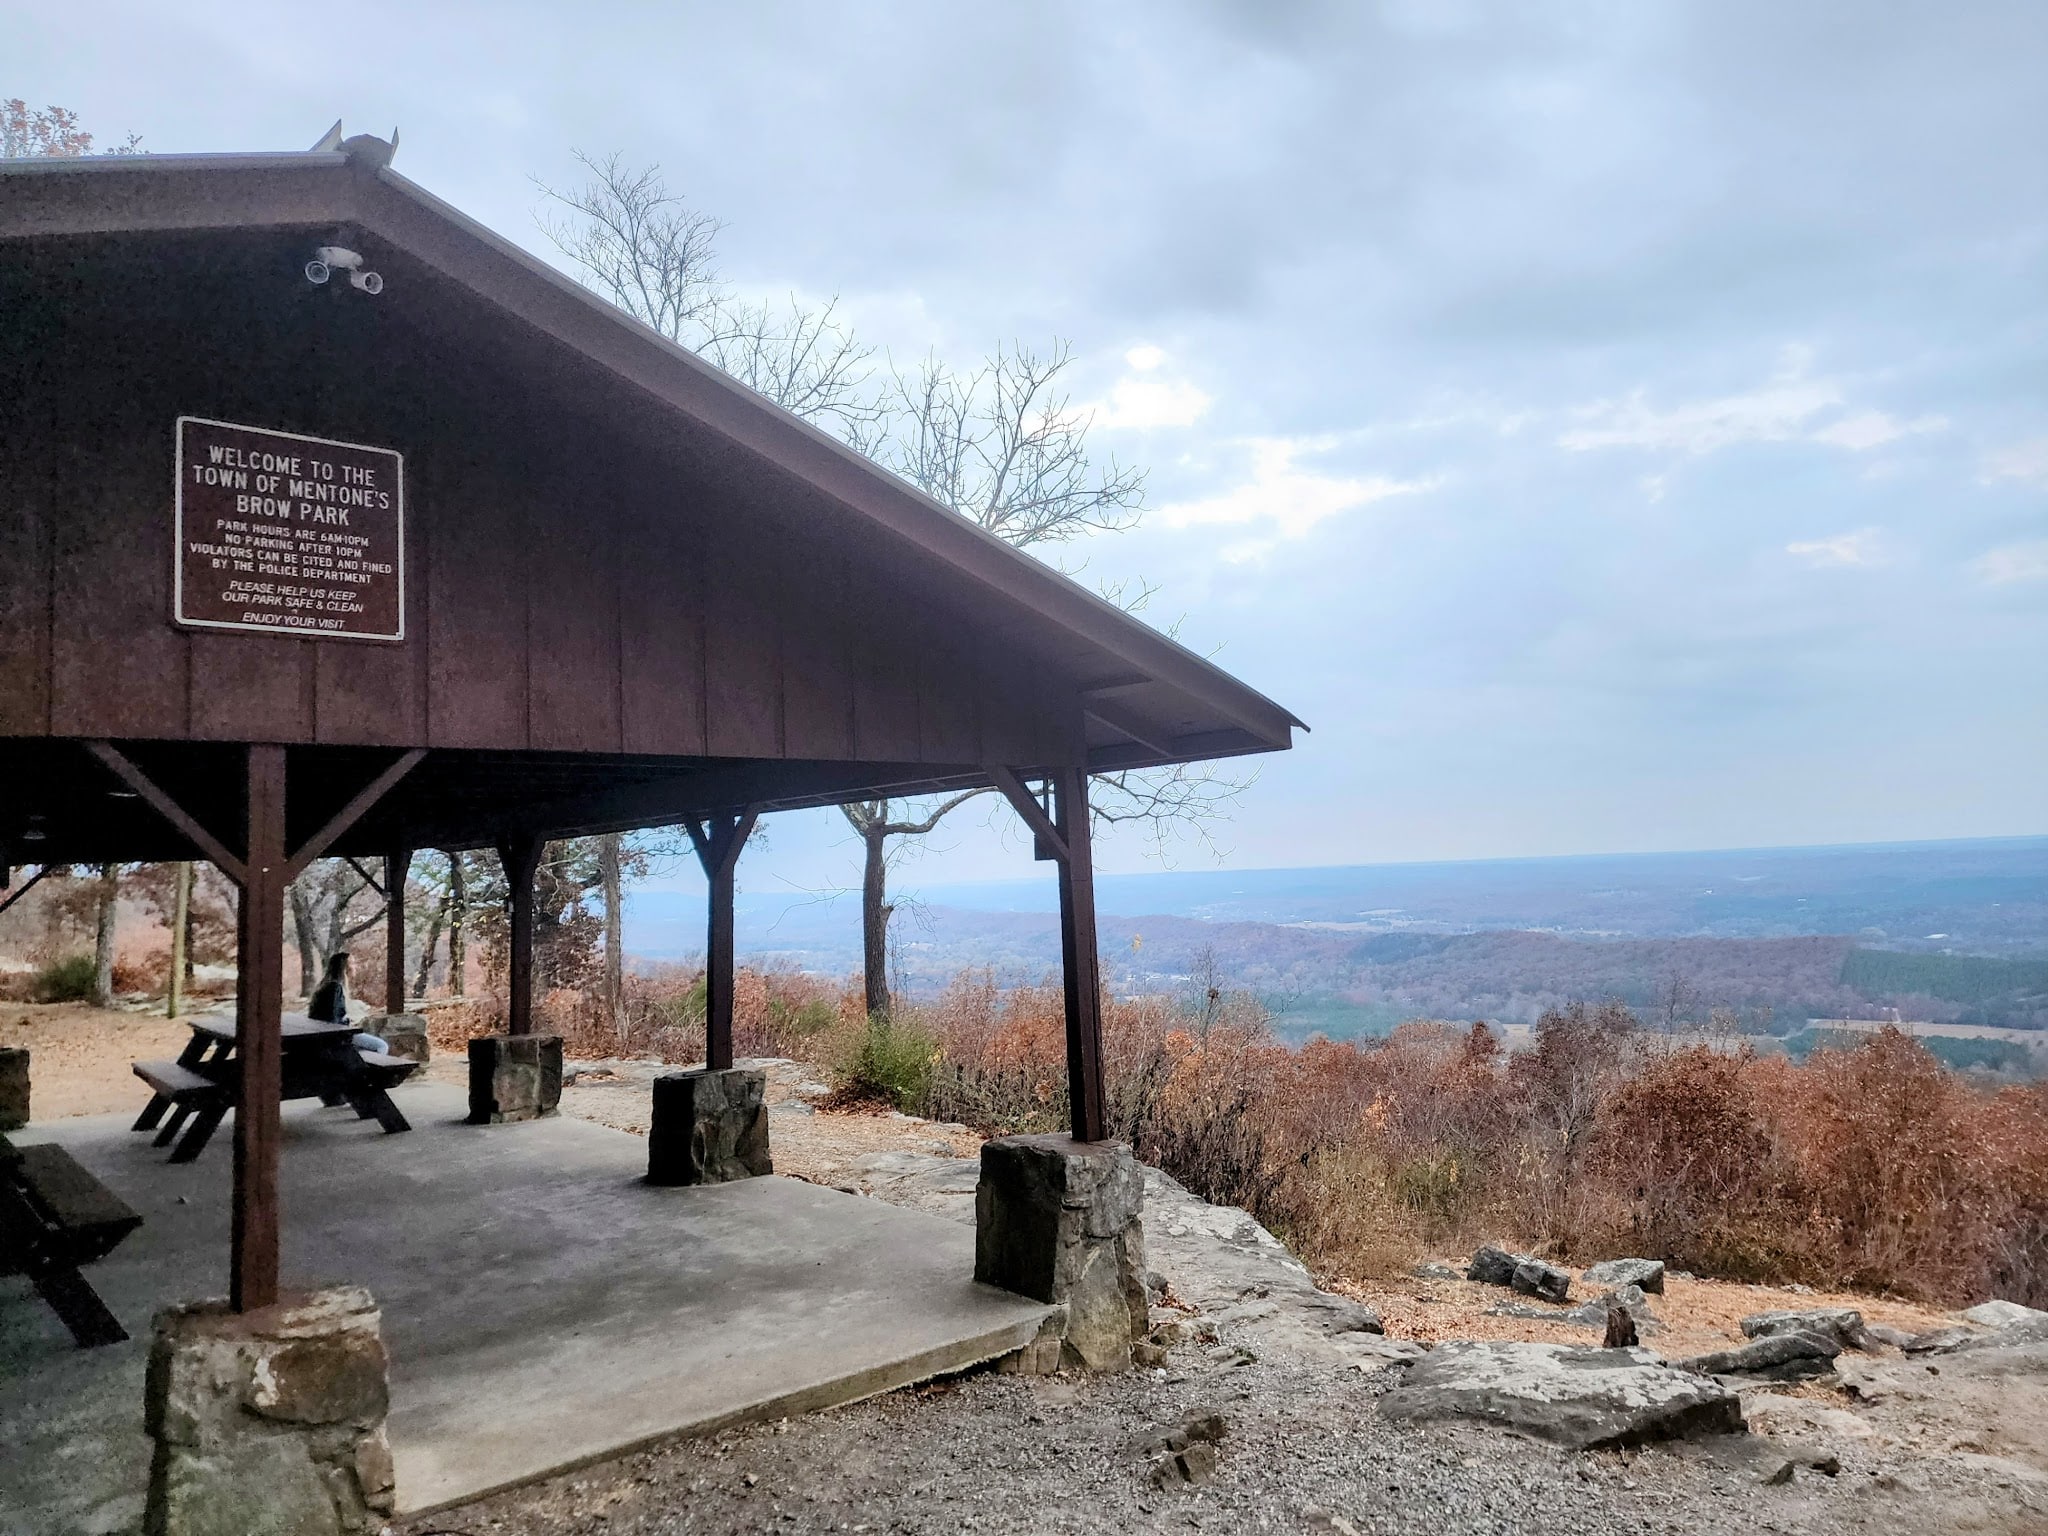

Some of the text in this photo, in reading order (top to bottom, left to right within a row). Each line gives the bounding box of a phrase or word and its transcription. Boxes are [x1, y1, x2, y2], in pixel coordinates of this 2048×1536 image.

[210, 445, 375, 486] WELCOME TO THE
[193, 465, 389, 509] TOWN OF MENTONE'S
[237, 495, 349, 526] BROW PARK
[217, 519, 369, 546] PARK HOURS ARE 6AM-10PM
[190, 543, 391, 574] VIOLATORS CAN BE CITED AND FINED
[225, 534, 362, 558] NO PARKING AFTER 10PM
[212, 558, 372, 584] BY THE POLICE DEPARTMENT
[223, 592, 363, 613] OUR PARK SAFE & CLEAN
[230, 581, 356, 600] PLEASE HELP US KEEP
[242, 612, 345, 629] ENJOY YOUR VISIT
